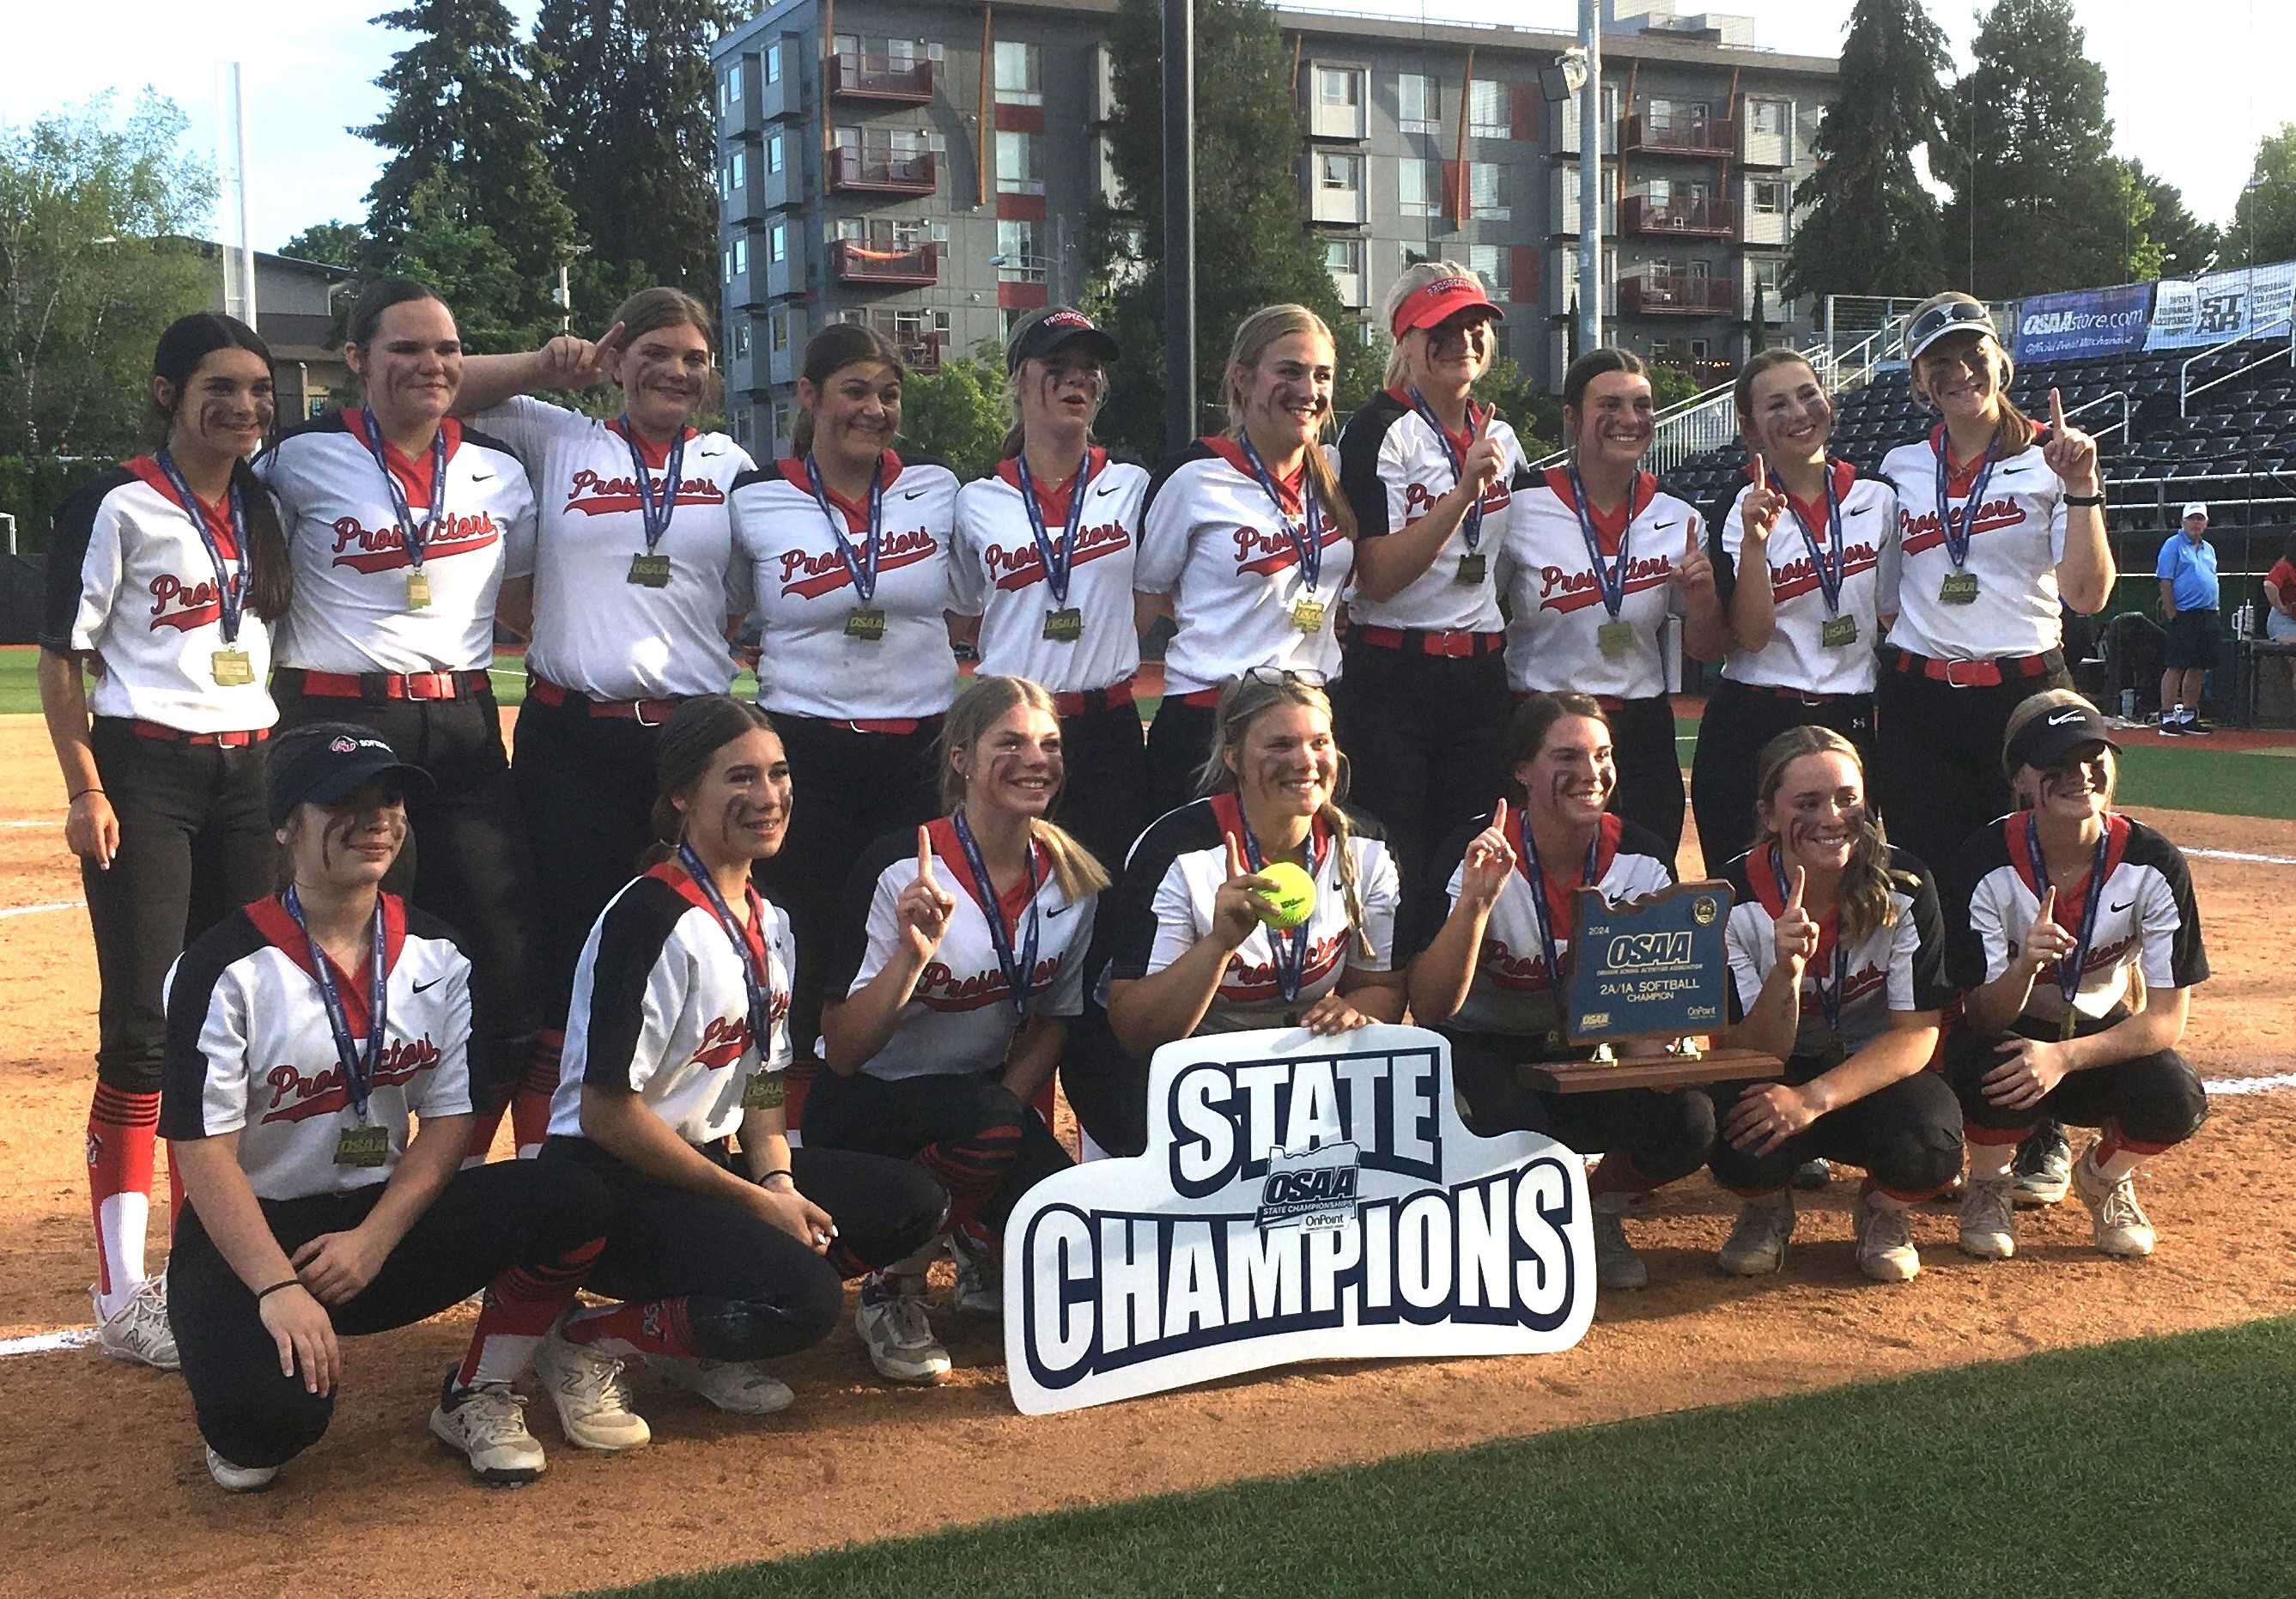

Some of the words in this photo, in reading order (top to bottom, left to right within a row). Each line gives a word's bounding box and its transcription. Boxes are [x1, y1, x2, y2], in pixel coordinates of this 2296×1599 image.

[1427, 278, 1477, 297] PROSPECTO
[1044, 312, 1095, 330] PROSPECT
[2022, 308, 2143, 336] OSAAstore.com
[568, 469, 722, 500] Proseors
[333, 511, 495, 554] Prosectors
[1899, 497, 2020, 535] Proseors
[780, 526, 936, 582] Prosetors
[985, 520, 1129, 581] Prosetors
[1540, 554, 1673, 599] Prosetors
[359, 739, 392, 752] SOFTB
[1588, 926, 1610, 935] 2024
[1607, 931, 1693, 969] OSAA
[1600, 982, 1633, 995] 2A/1A
[1639, 978, 1700, 992] SOFTBALL
[1627, 992, 1674, 1003] CHAMPION
[267, 1032, 440, 1108] Prosctors
[1169, 1047, 1443, 1198] STATE
[1262, 1165, 1358, 1207] OSAA
[1263, 1206, 1287, 1215] STATE
[1288, 1201, 1354, 1213] CHAMPIONSHIPS
[1305, 1213, 1344, 1226] OnPoint
[1023, 1157, 1575, 1389] CHAMPIONS
